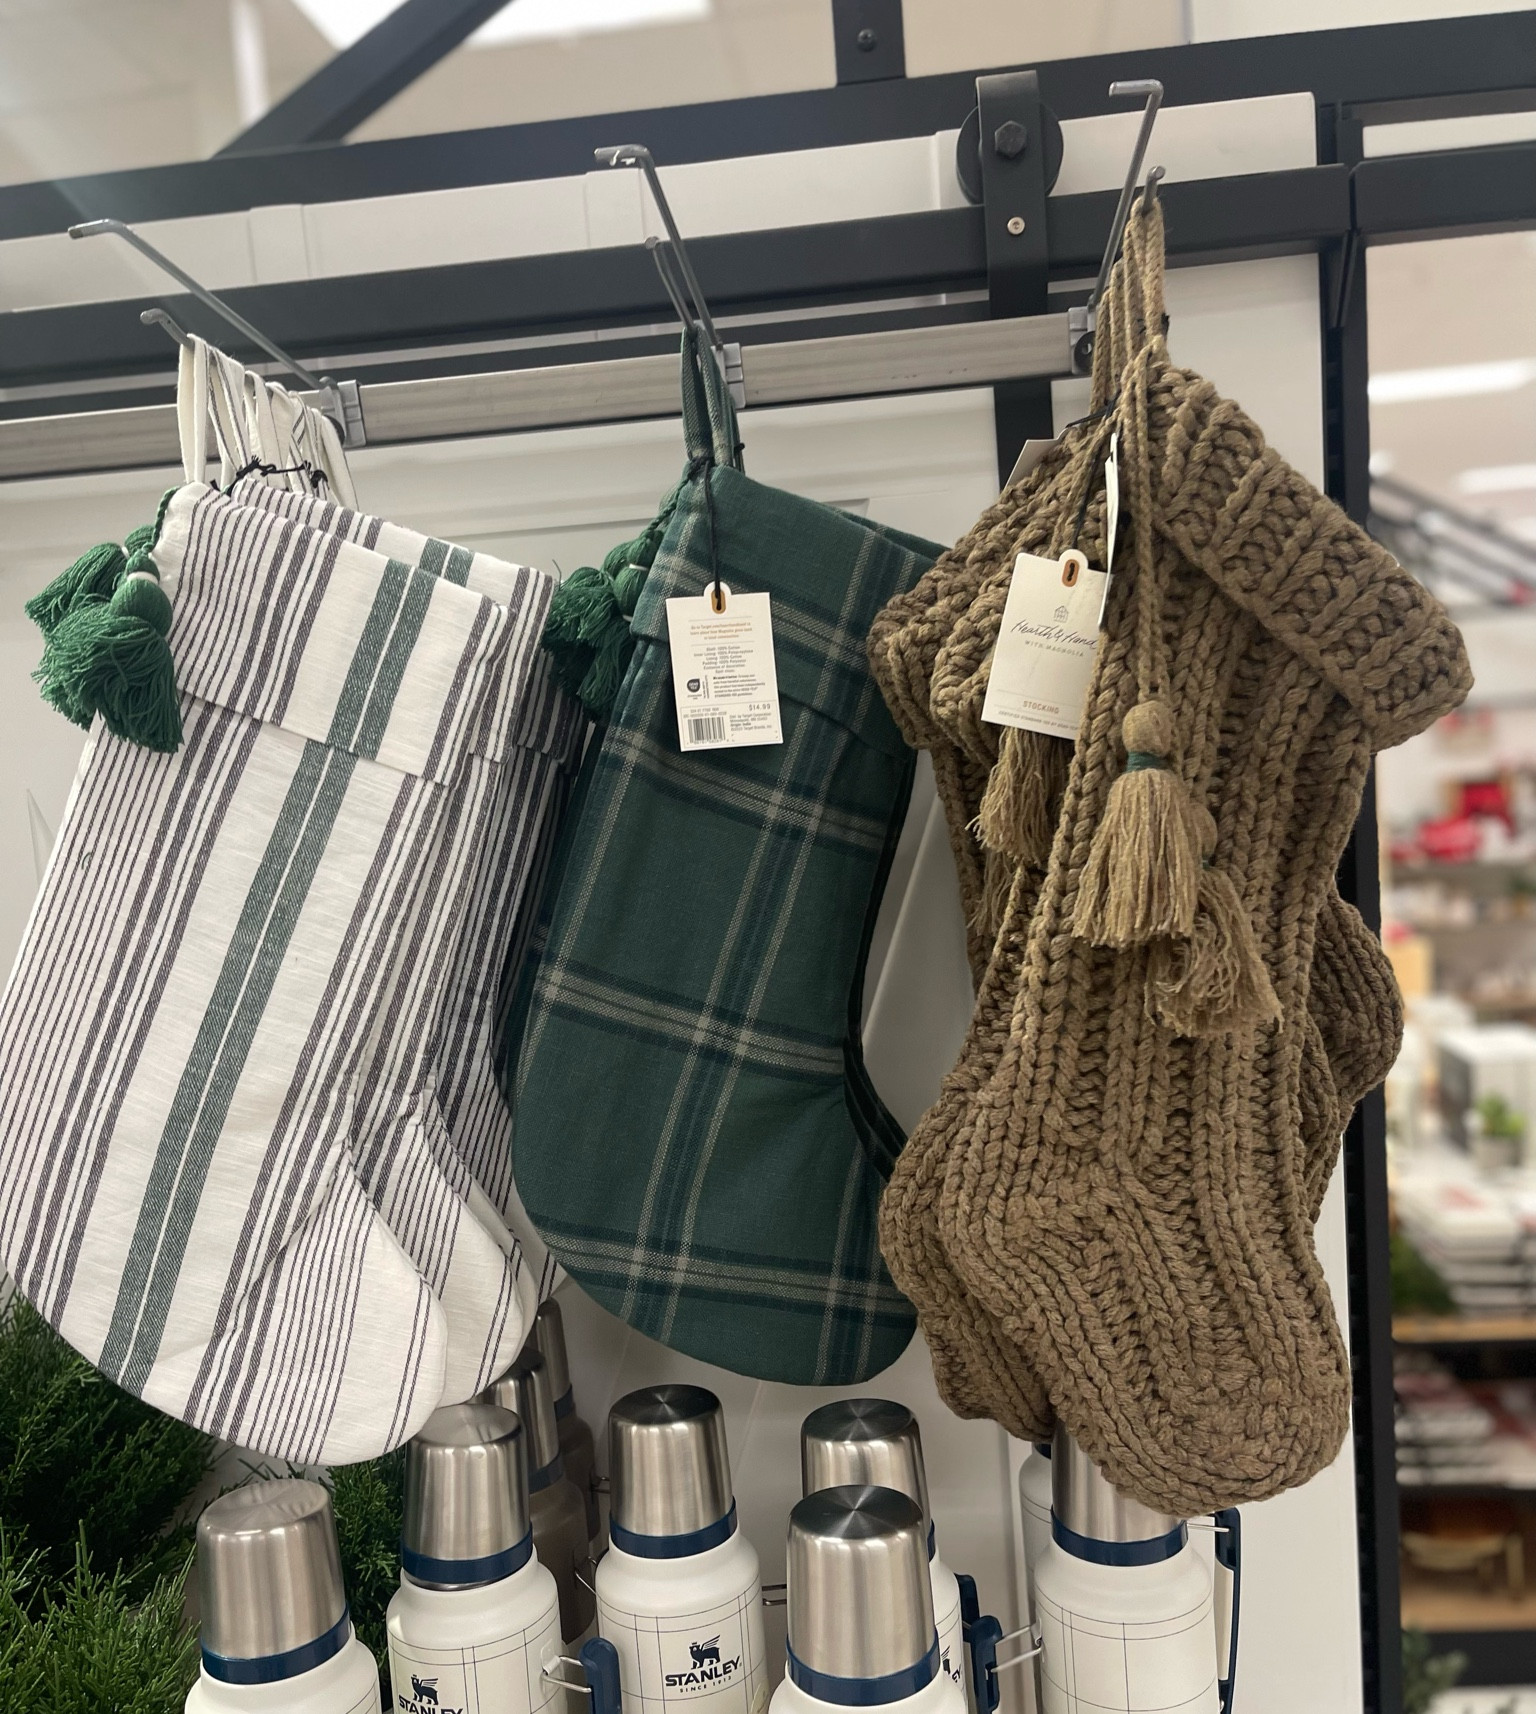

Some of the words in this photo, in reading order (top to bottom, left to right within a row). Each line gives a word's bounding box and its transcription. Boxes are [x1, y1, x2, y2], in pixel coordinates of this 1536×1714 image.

[1010, 618, 1059, 640] Hearth
[1024, 640, 1043, 648] WITH
[1046, 644, 1084, 657] MAGNOLIA
[749, 703, 771, 711] $14.99
[1022, 700, 1060, 714] STOCKING
[665, 1655, 740, 1687] STANLEY
[680, 1684, 706, 1693] SINCE
